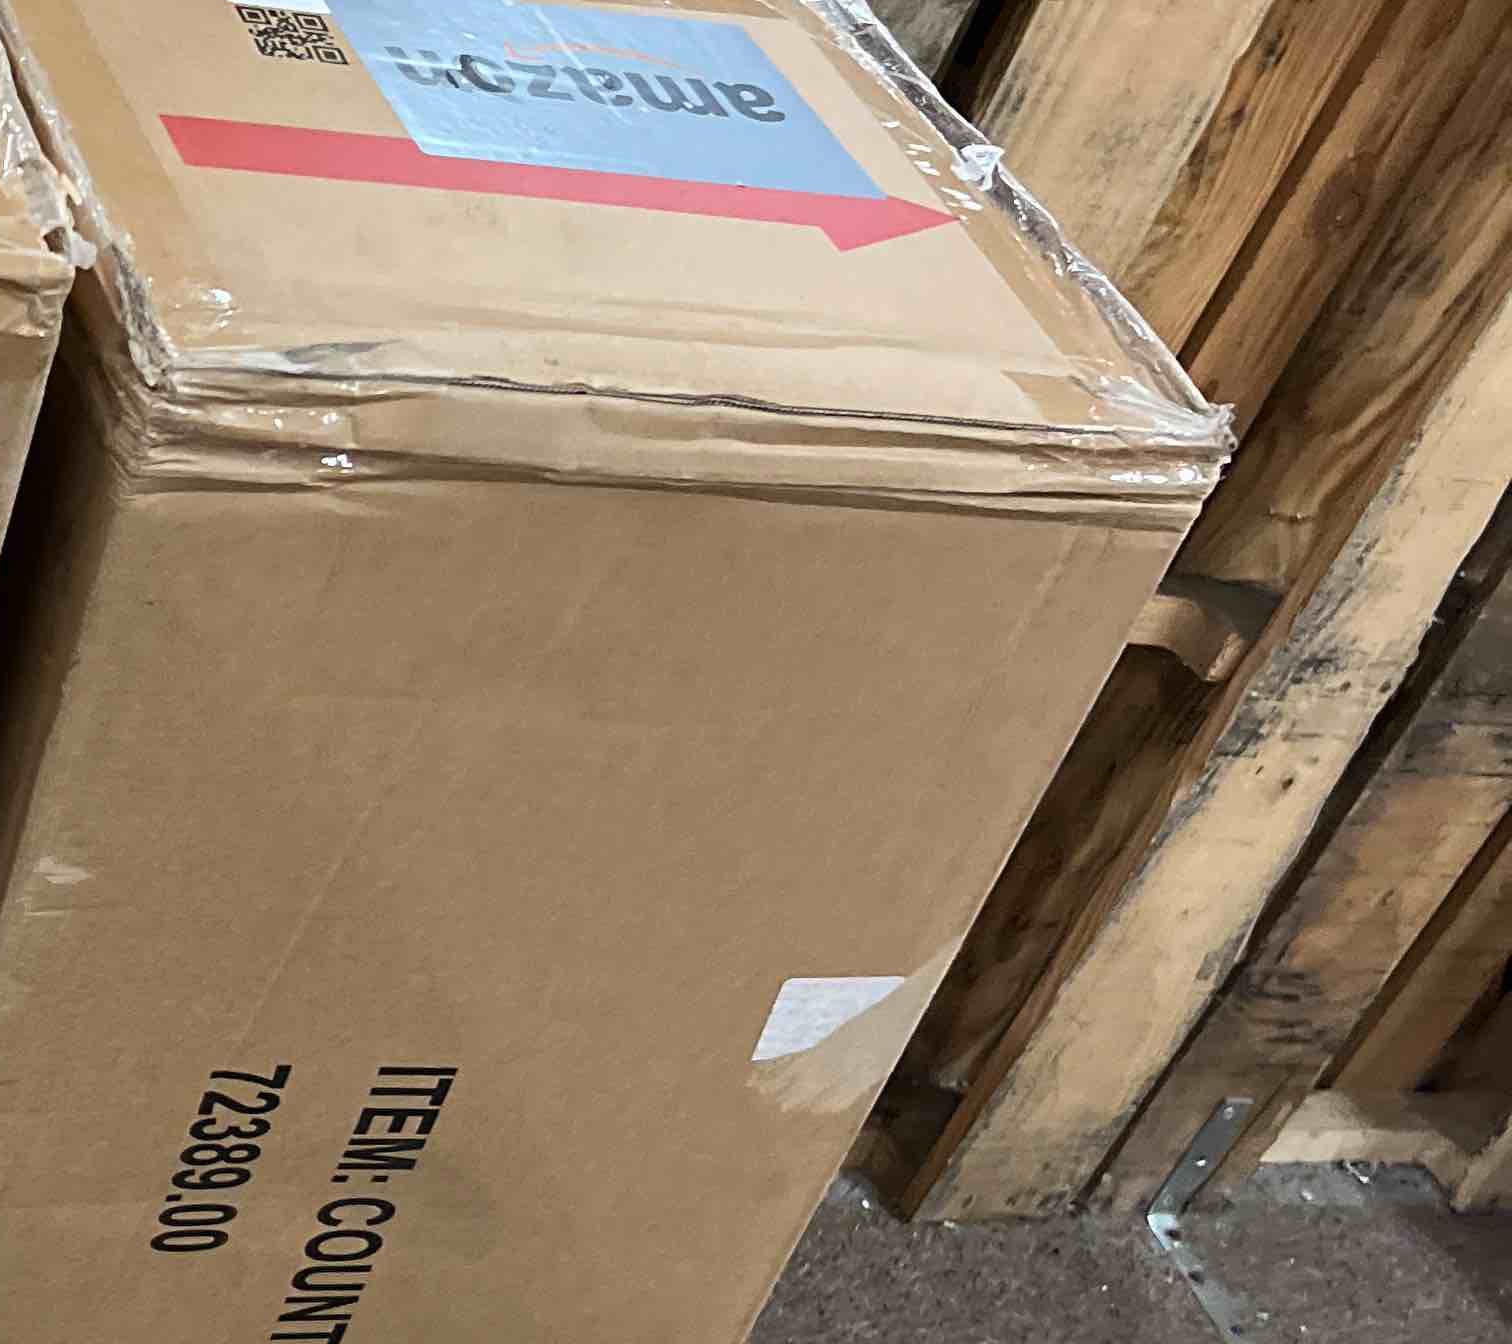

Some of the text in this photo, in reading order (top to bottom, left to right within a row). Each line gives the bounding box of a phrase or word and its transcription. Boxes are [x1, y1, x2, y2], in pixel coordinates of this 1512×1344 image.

[384, 44, 787, 124] amazon
[149, 1063, 293, 1254] 72389.00
[329, 1065, 460, 1185] ITEM:
